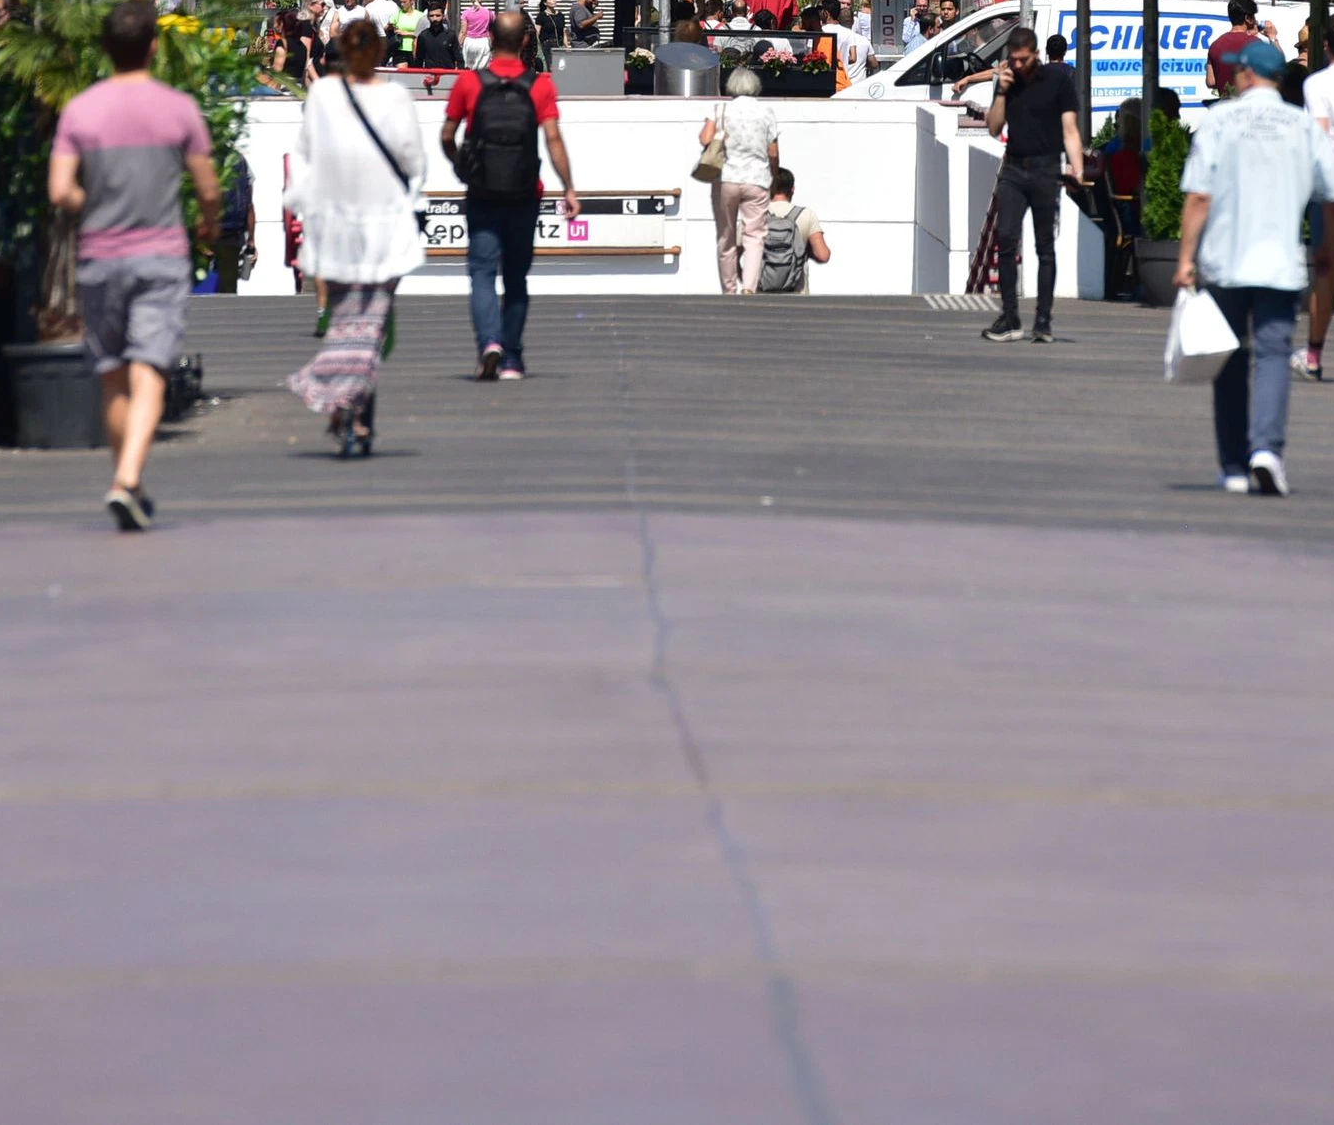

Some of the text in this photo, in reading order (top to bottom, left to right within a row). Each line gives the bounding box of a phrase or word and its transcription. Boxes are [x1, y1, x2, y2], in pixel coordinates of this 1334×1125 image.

[1067, 25, 1214, 51] SCHILER
[1096, 59, 1142, 73] wasse
[570, 226, 586, 238] U1
